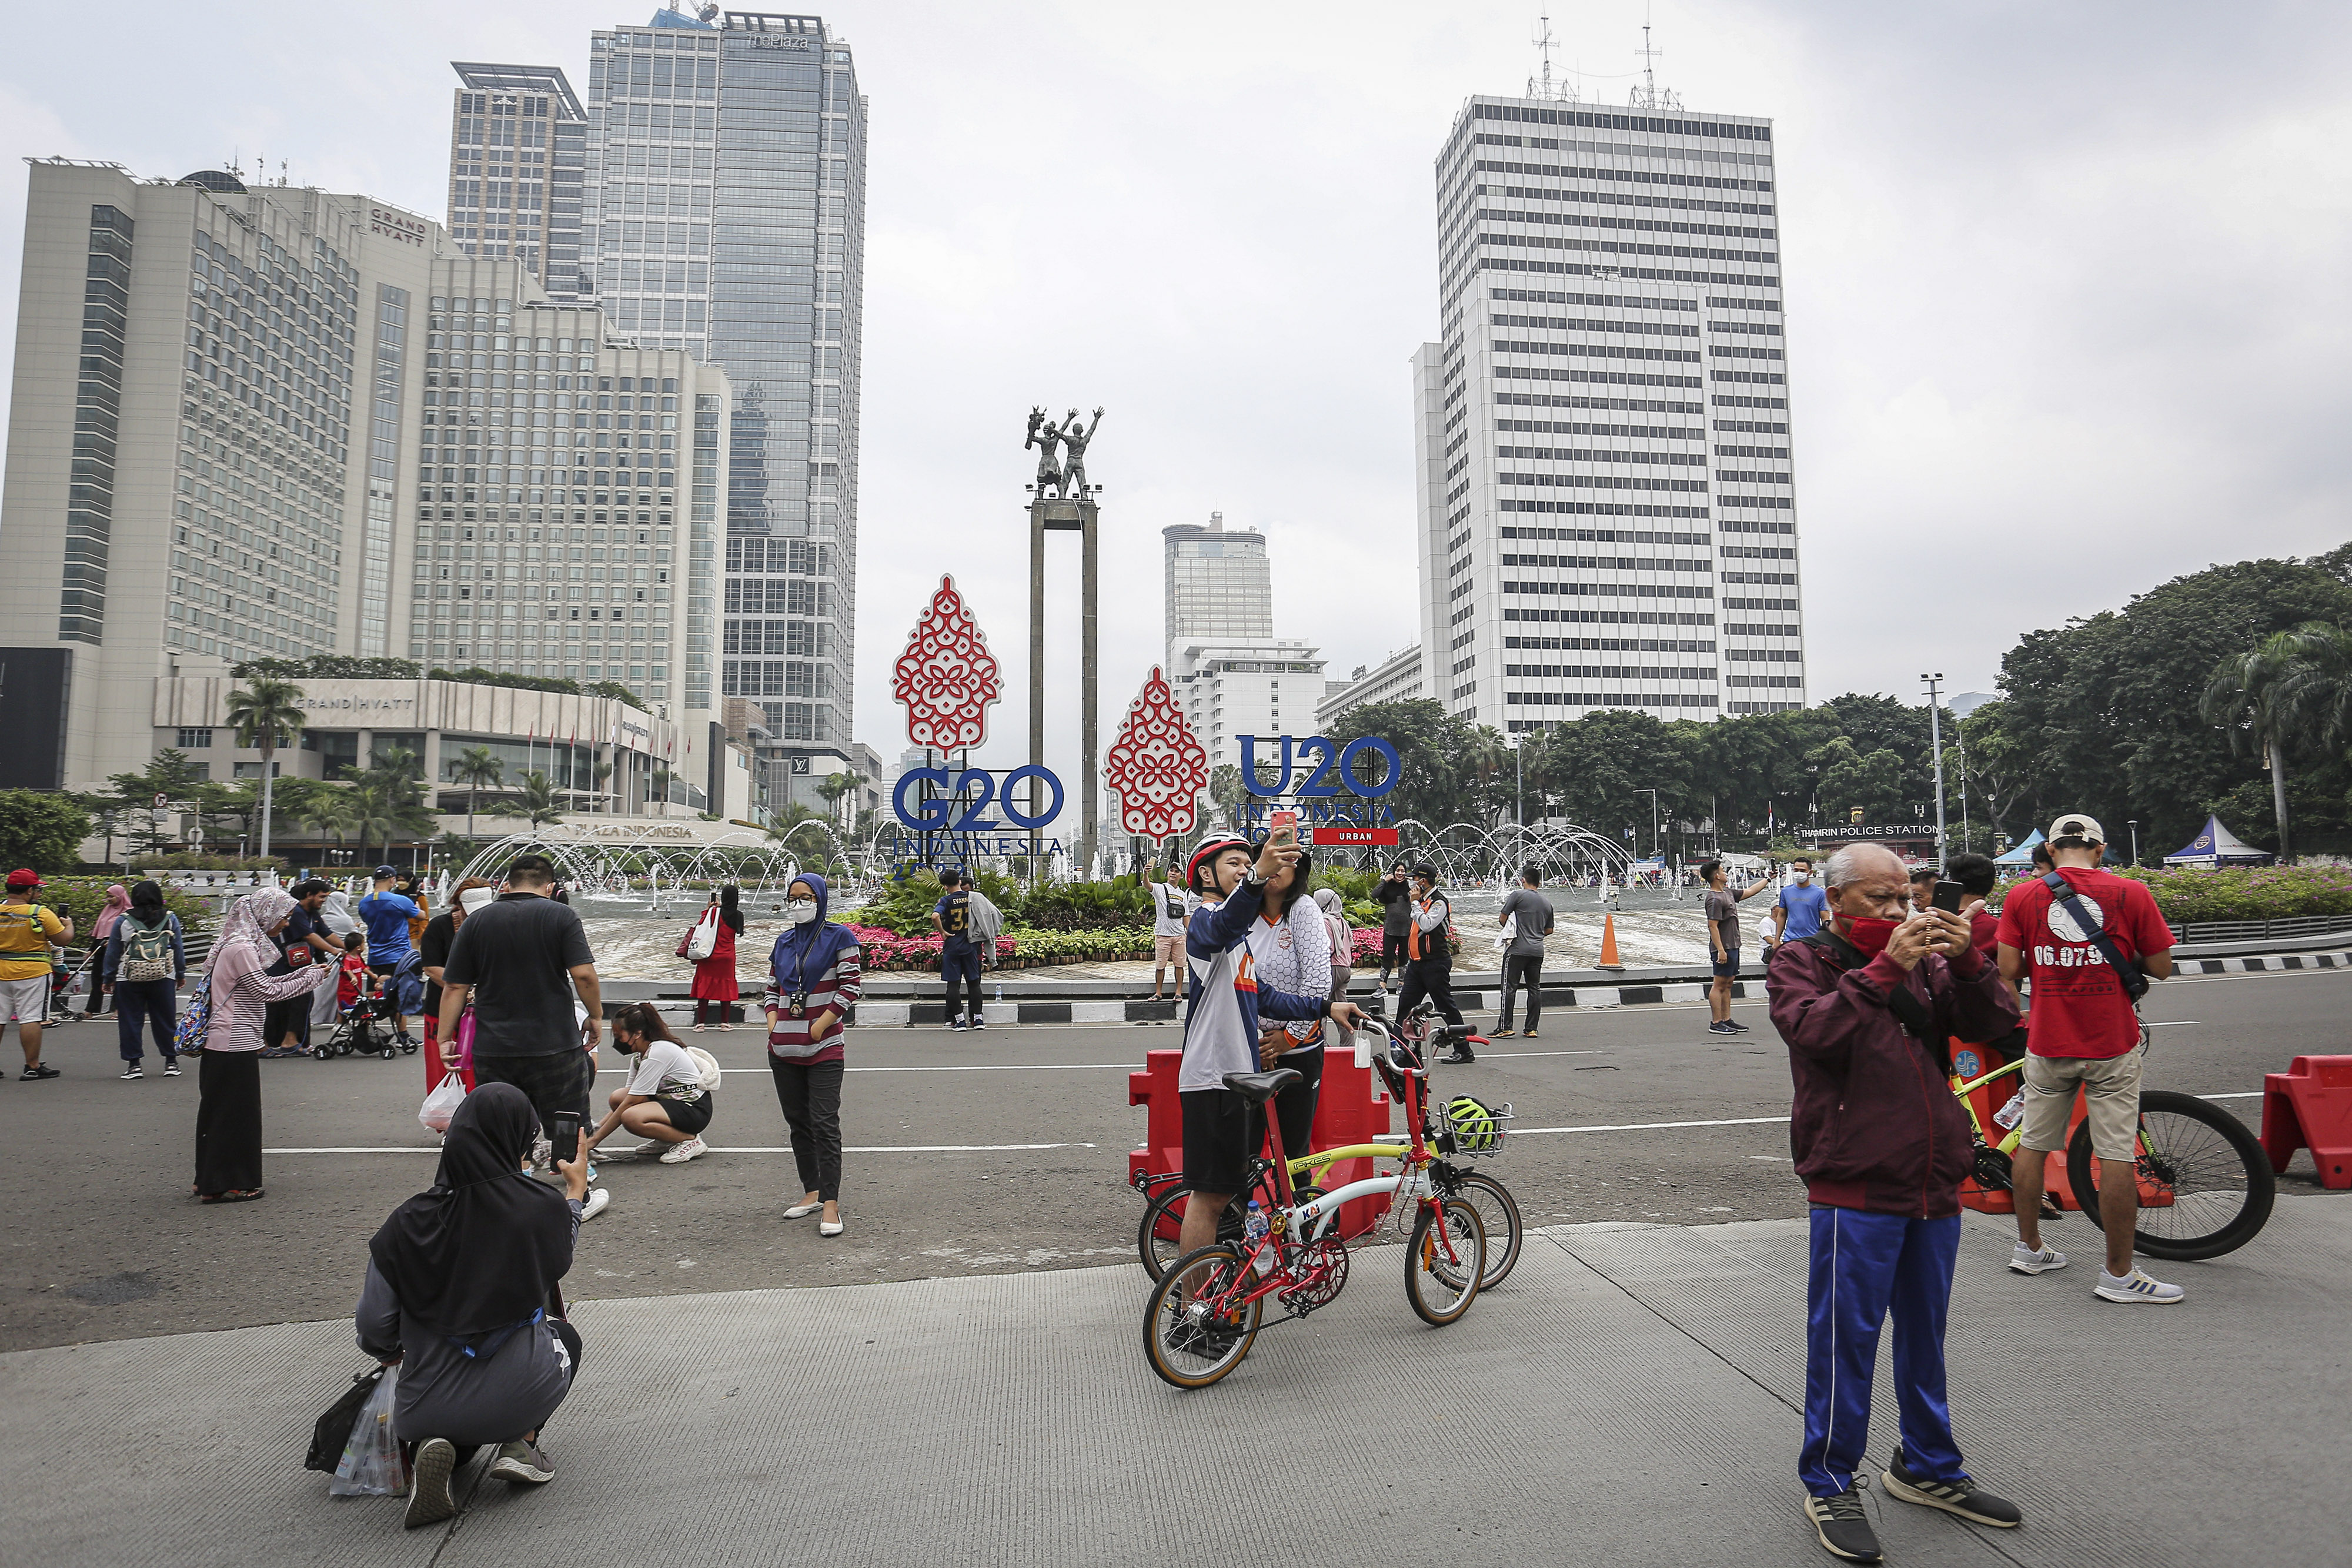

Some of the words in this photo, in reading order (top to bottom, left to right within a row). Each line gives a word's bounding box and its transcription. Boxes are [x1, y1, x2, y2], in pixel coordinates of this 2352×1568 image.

[372, 208, 426, 233] GRAND
[372, 223, 423, 247] HYATT
[359, 698, 413, 709] HYATT
[1235, 735, 1401, 797] U20
[893, 764, 1064, 831] G20
[575, 824, 620, 835] PLAZA
[623, 825, 692, 838] INDONESIA
[1339, 833, 1372, 841] URBAN
[1800, 828, 1838, 838] THAMRIN
[1840, 826, 1882, 836] POLICE
[892, 838, 1064, 855] INDONESIA
